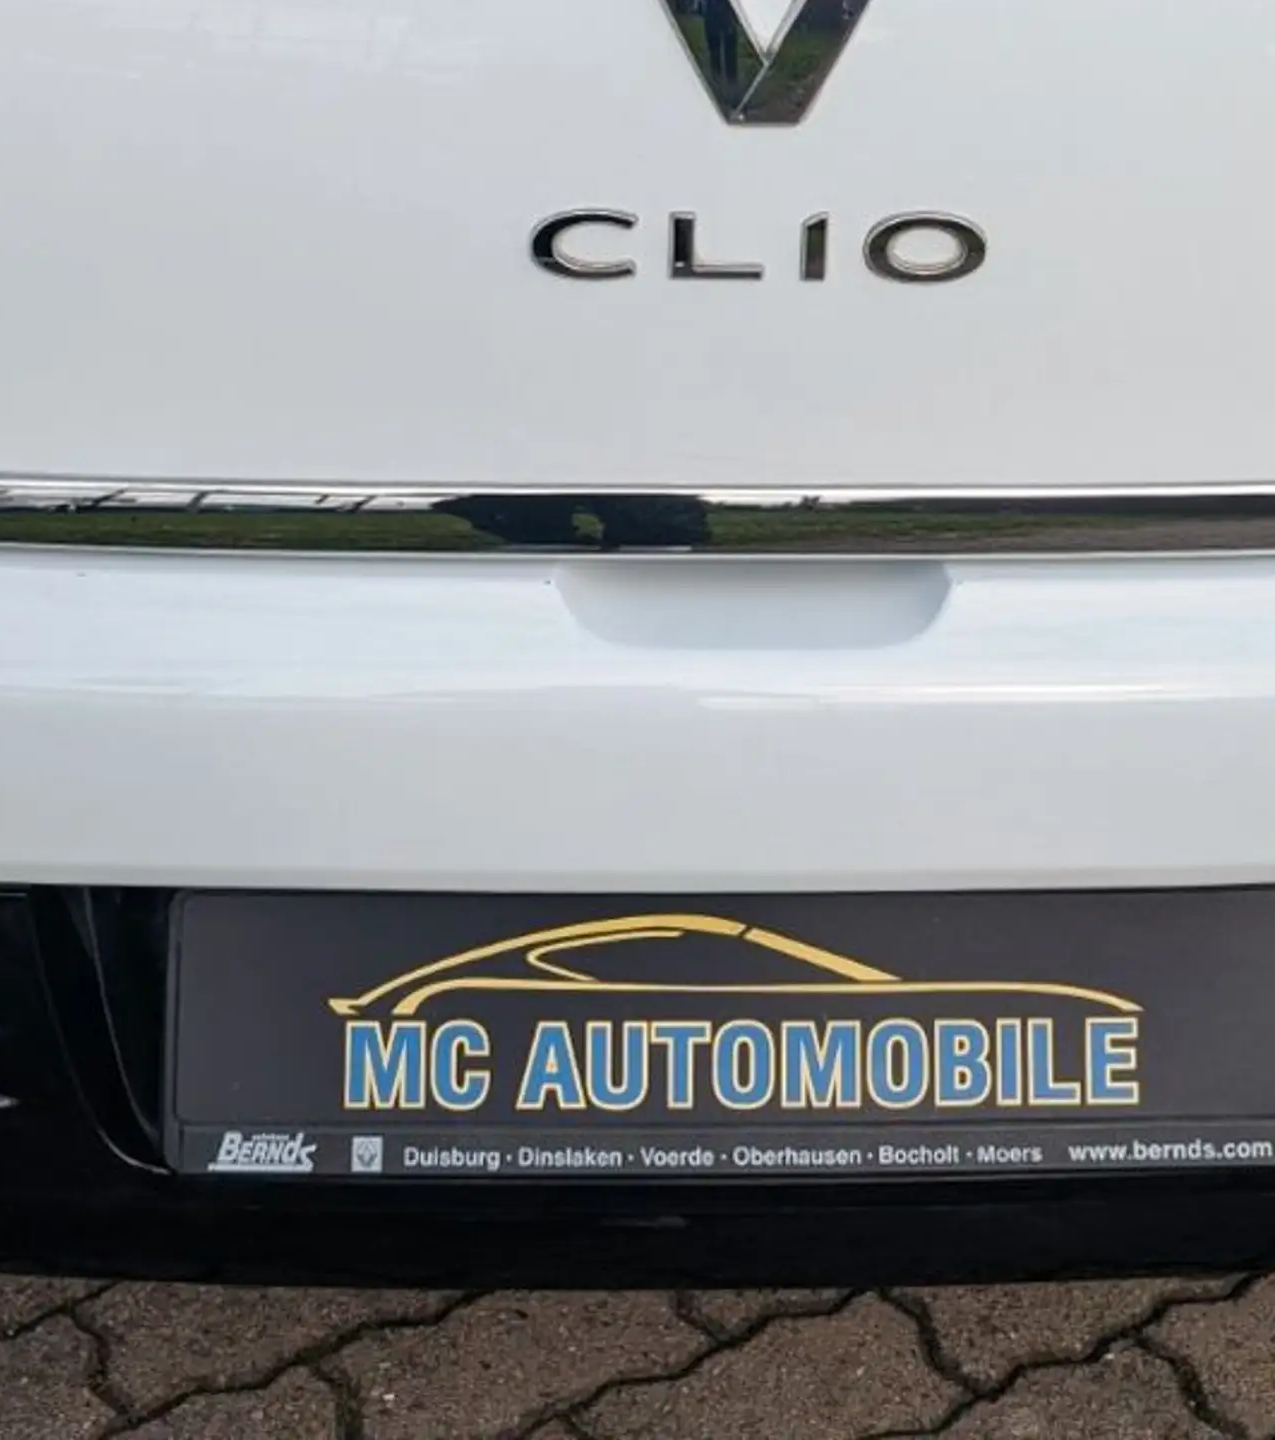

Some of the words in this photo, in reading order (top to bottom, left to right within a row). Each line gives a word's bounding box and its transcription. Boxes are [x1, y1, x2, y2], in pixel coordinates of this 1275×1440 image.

[531, 208, 988, 283] CLIO
[343, 1018, 492, 1111] MC
[516, 1016, 1142, 1111] AUTOMOBILE
[403, 1146, 501, 1172] Duisburg
[518, 1146, 622, 1167] Dinslaken
[640, 1146, 714, 1167] Voerde
[733, 1145, 862, 1167] Oberhausen
[878, 1144, 959, 1164] Bocholt
[977, 1145, 1043, 1163] Moers
[1068, 1138, 1274, 1162] www.bernds.com
